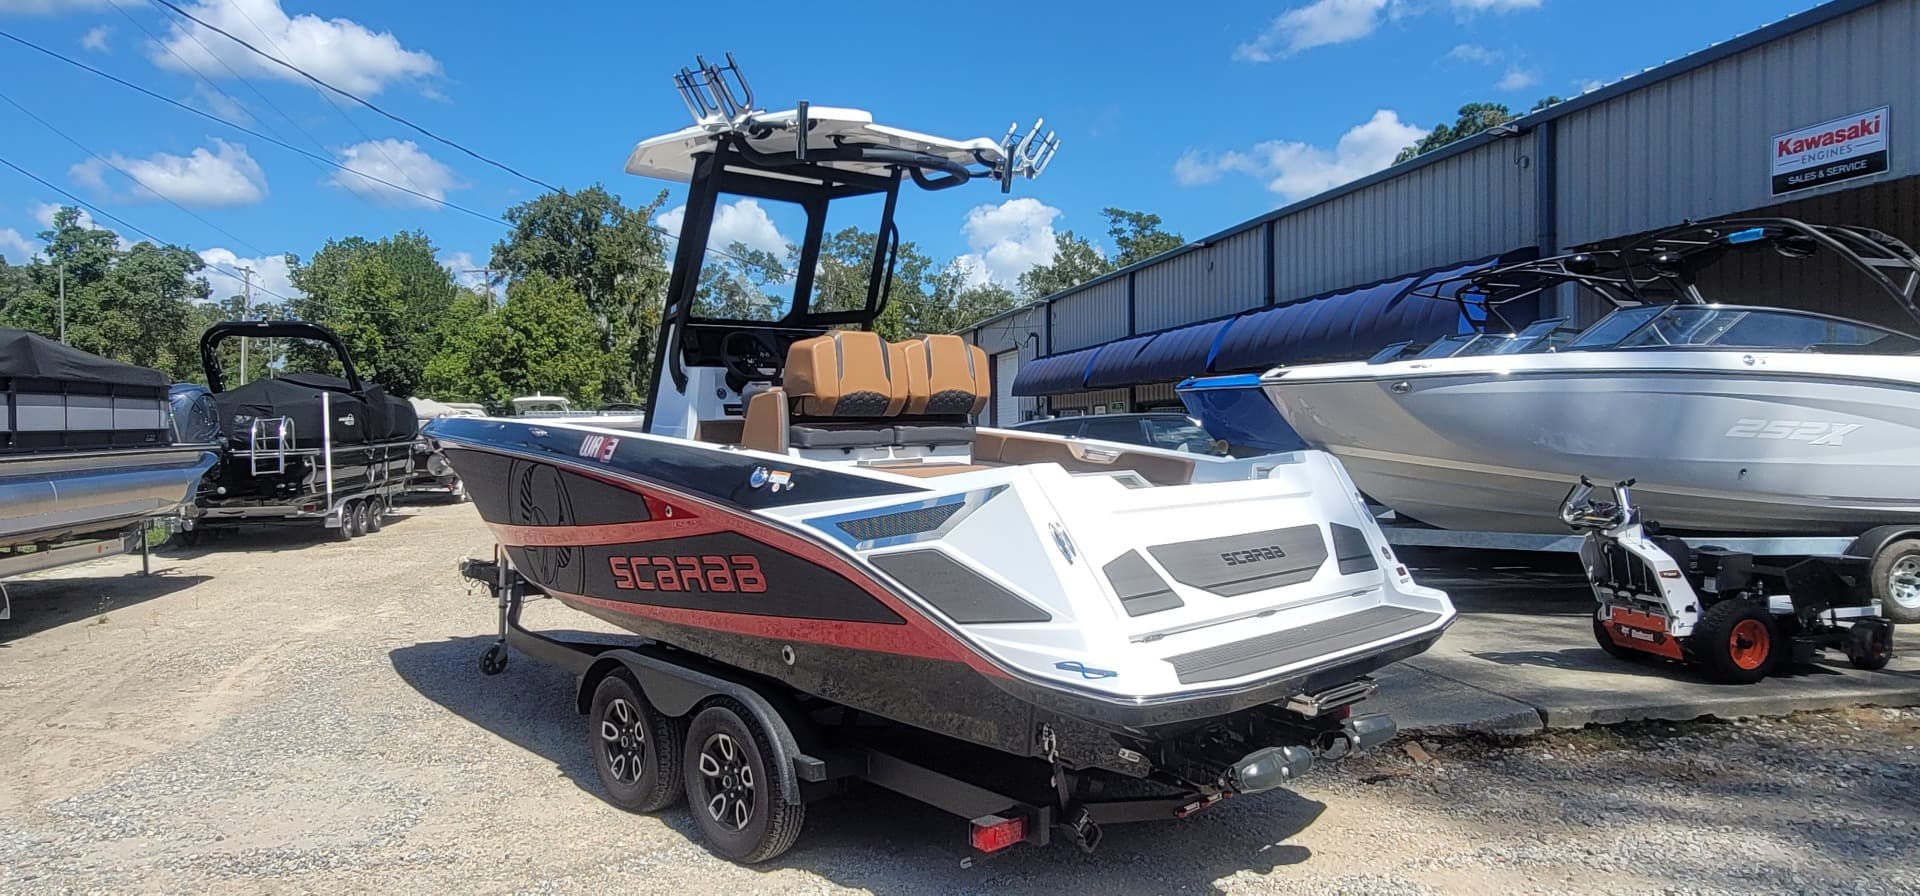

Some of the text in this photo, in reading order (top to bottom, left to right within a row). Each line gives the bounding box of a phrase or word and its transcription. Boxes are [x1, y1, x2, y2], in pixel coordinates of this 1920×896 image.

[1777, 115, 1881, 158] Kawasaki
[1801, 144, 1853, 165] ENGINES
[1788, 160, 1869, 185] SALES & SERVICE
[1725, 418, 1864, 446] 252X
